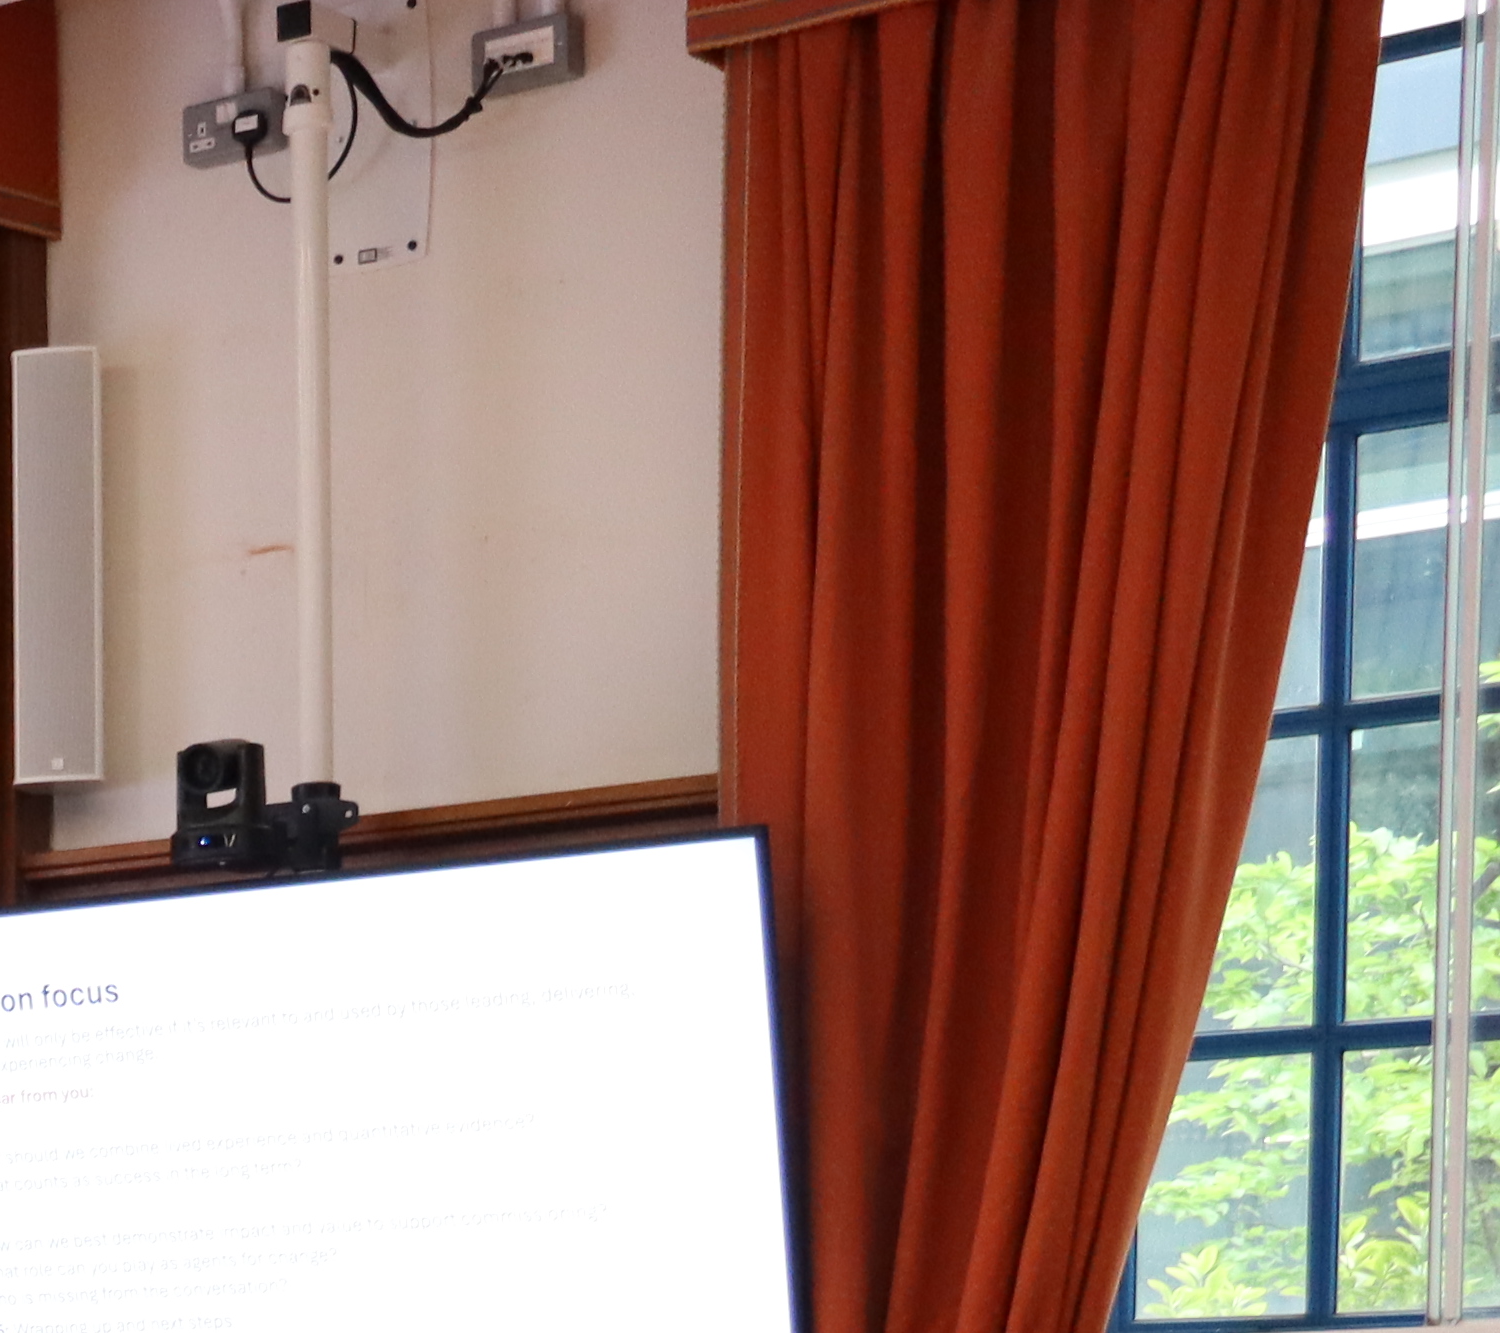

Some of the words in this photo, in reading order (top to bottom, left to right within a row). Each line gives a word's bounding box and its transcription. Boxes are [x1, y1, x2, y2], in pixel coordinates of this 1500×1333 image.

[41, 983, 119, 1008] focus
[20, 1089, 58, 1103] from
[61, 1087, 93, 1104] you:
